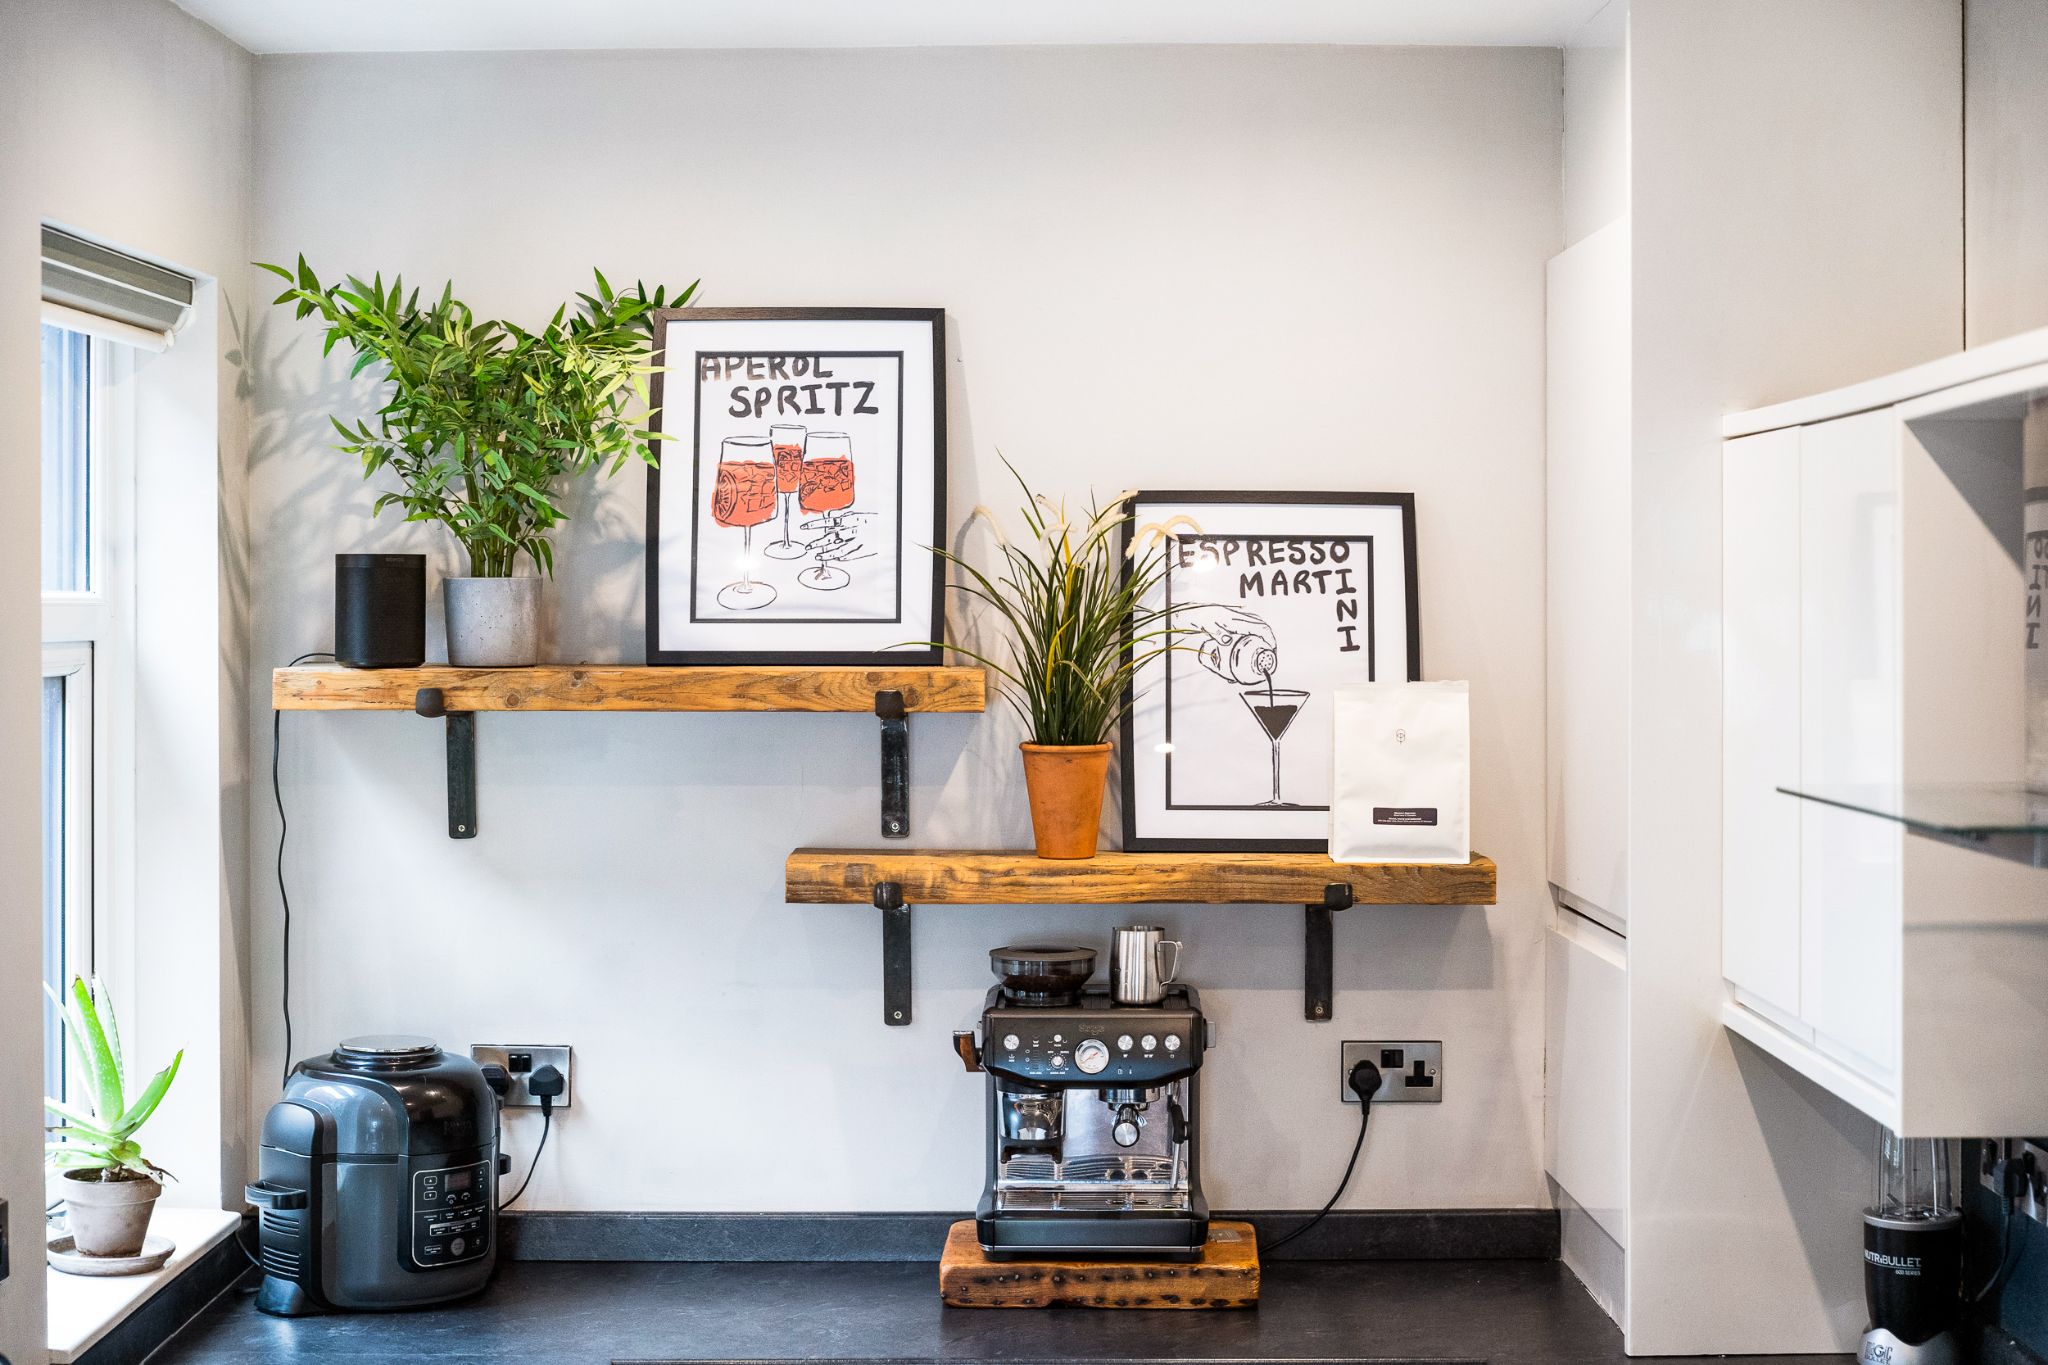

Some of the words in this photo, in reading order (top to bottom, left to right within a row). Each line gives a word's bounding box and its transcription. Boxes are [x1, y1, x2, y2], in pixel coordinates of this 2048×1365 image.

[701, 354, 833, 382] APEROL
[728, 381, 879, 418] SPRITZ
[1178, 539, 1350, 568] ESPRESSO
